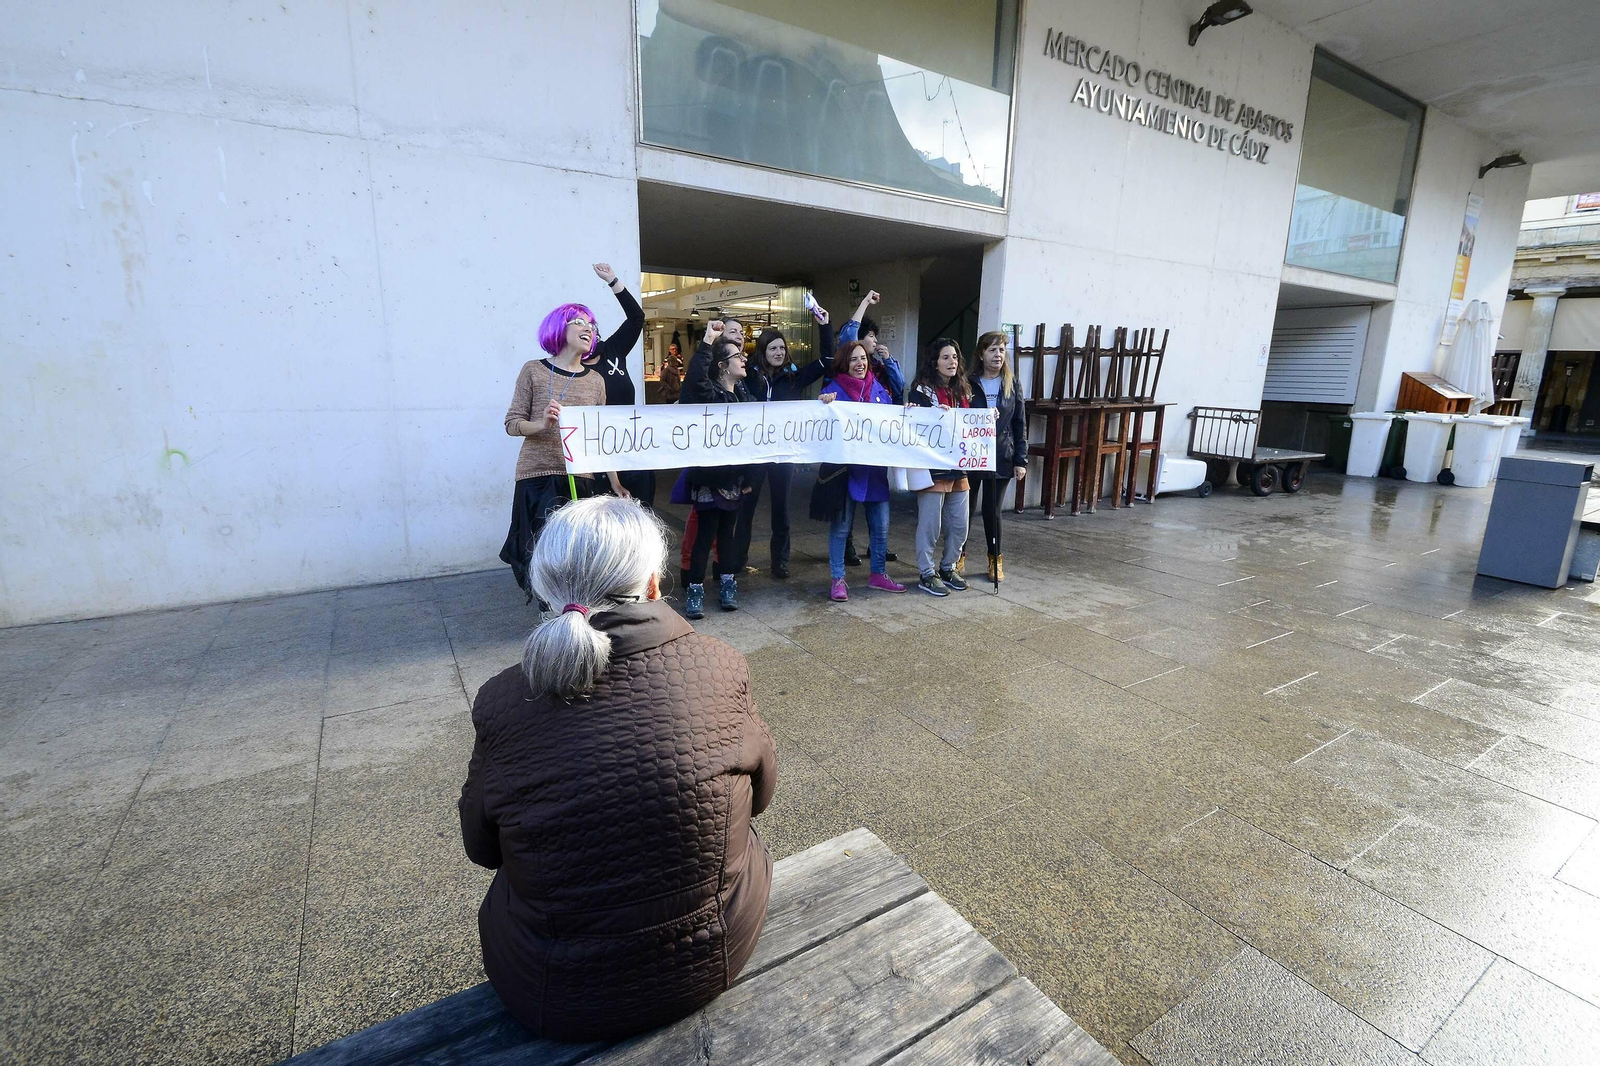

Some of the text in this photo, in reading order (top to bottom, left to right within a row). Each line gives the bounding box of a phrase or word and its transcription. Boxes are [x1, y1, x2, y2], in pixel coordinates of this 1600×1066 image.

[1043, 27, 1293, 143] MERCADO CENTRAL DE ABASTOS
[1070, 77, 1271, 165] AYUNTAMIENTO DE CÁDIZ
[582, 409, 660, 457] Hasta
[753, 404, 777, 446] de
[783, 418, 840, 443] currar
[843, 413, 873, 444] sin
